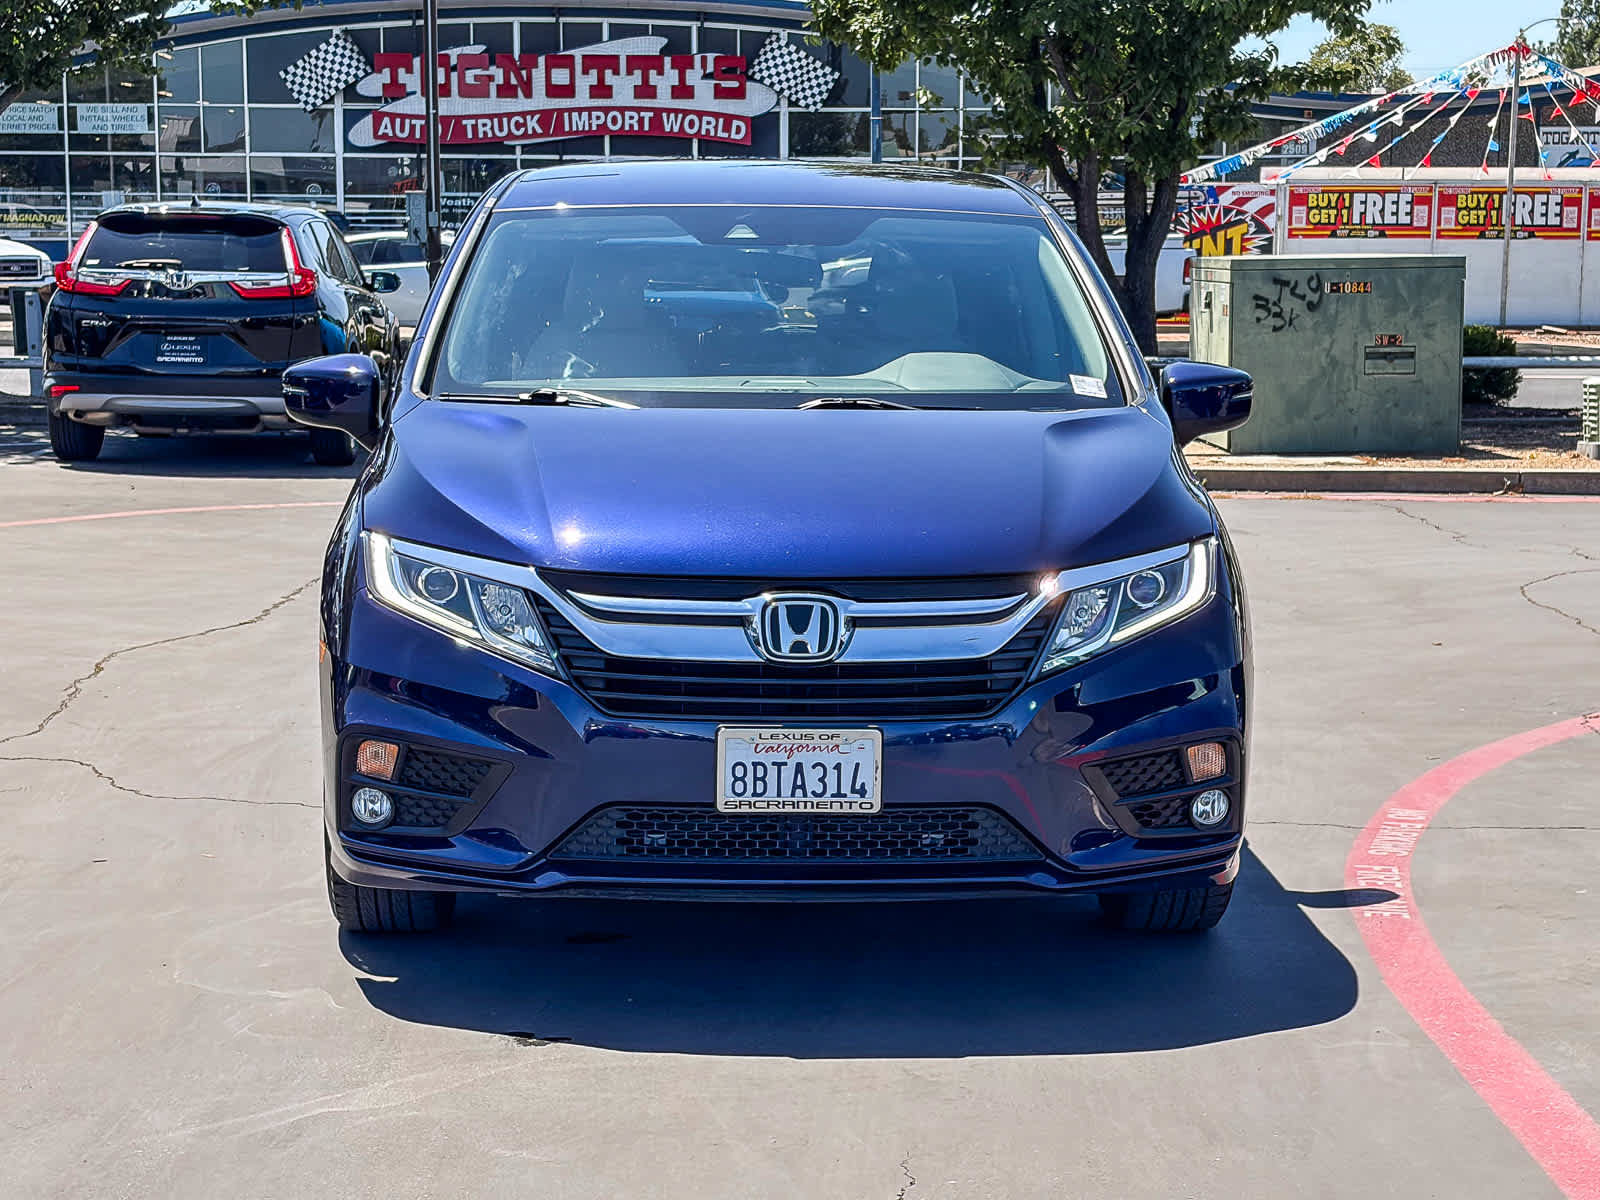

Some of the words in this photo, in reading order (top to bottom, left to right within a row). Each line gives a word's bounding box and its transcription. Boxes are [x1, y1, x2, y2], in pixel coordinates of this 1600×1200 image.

[87, 105, 98, 113] WE
[100, 105, 118, 113] SELL
[121, 105, 138, 113] AND
[80, 114, 109, 122] INSTALL
[111, 114, 146, 122] WHEELS
[378, 116, 442, 139] AUT
[462, 113, 543, 140] TRUCK
[564, 110, 654, 132] IMPORT
[662, 112, 747, 141] WORLD
[29, 123, 57, 131] PRICES
[91, 123, 109, 131] AND
[1308, 192, 1339, 207] BUY
[1342, 192, 1350, 207] 1
[1457, 193, 1489, 208] BUY
[1492, 193, 1500, 208] 1
[1352, 192, 1413, 224] FREE
[1502, 193, 1563, 226] FREE
[1308, 209, 1338, 223] GET
[1341, 209, 1349, 224] 1
[1457, 210, 1487, 225] GET
[1490, 210, 1498, 225] 1
[1324, 281, 1373, 294] U-10844
[1375, 334, 1404, 345] SW-2
[758, 732, 815, 741] LEXUS
[818, 732, 841, 741] OF
[753, 743, 852, 760] California
[731, 761, 868, 799] 8BTA314
[723, 799, 875, 811] SACRAMENTO
[1353, 864, 1403, 889] FIRE
